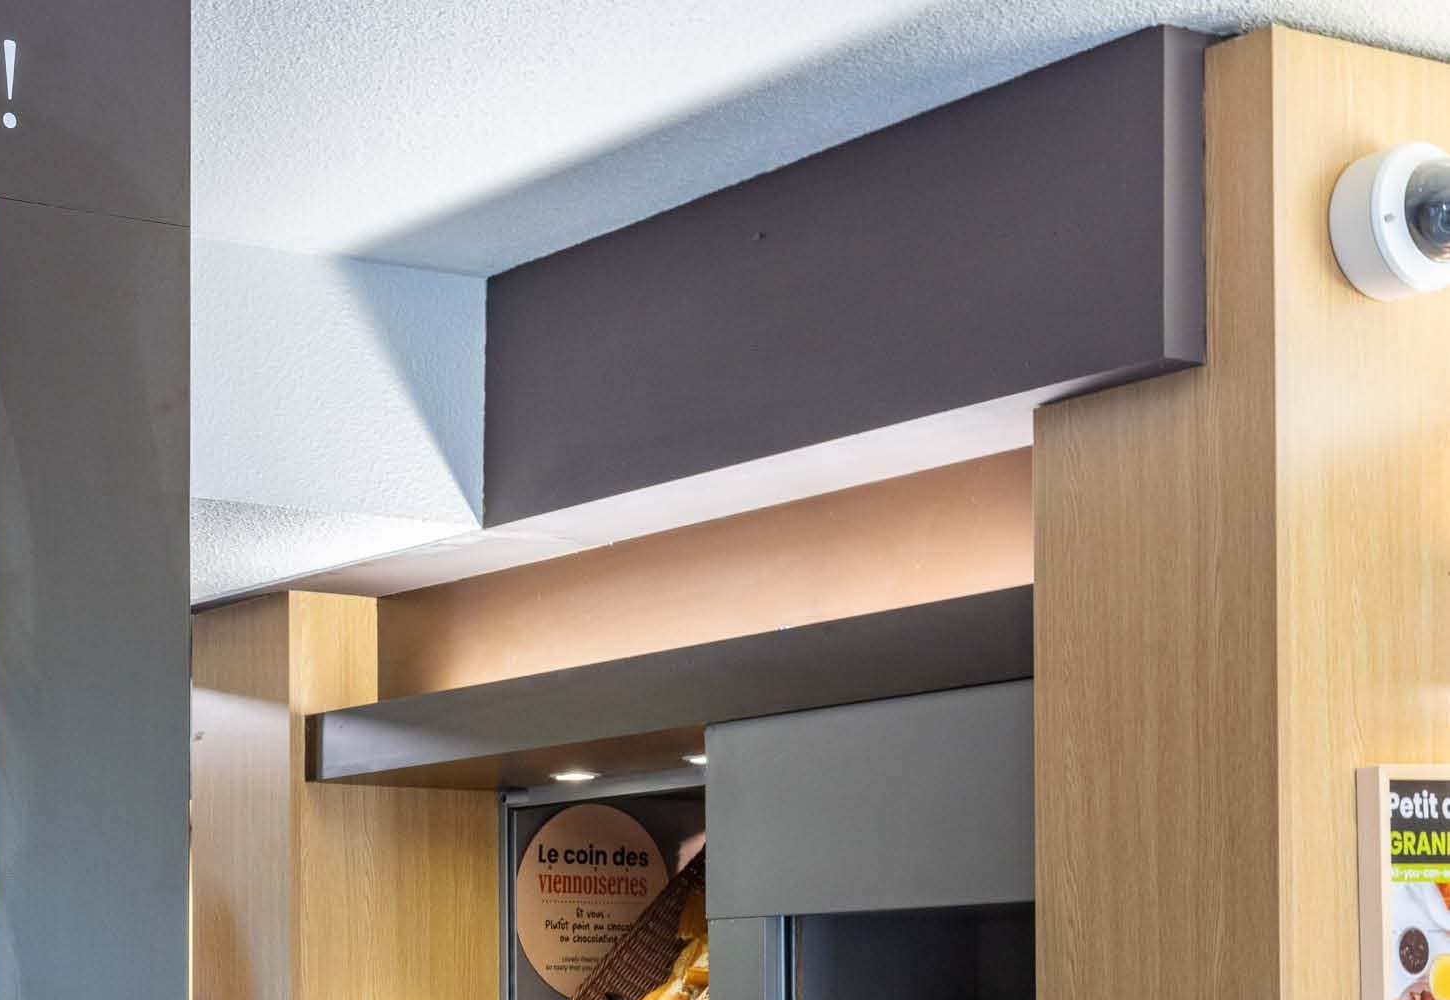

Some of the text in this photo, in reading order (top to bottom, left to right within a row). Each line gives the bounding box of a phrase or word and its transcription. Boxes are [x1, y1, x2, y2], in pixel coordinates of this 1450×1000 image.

[3, 40, 19, 129] !
[1389, 789, 1439, 820] Petit
[538, 844, 649, 867] Le coin des
[1391, 830, 1450, 857] GRAN
[545, 918, 590, 933] Plutôt pain
[576, 907, 605, 919] Et vous
